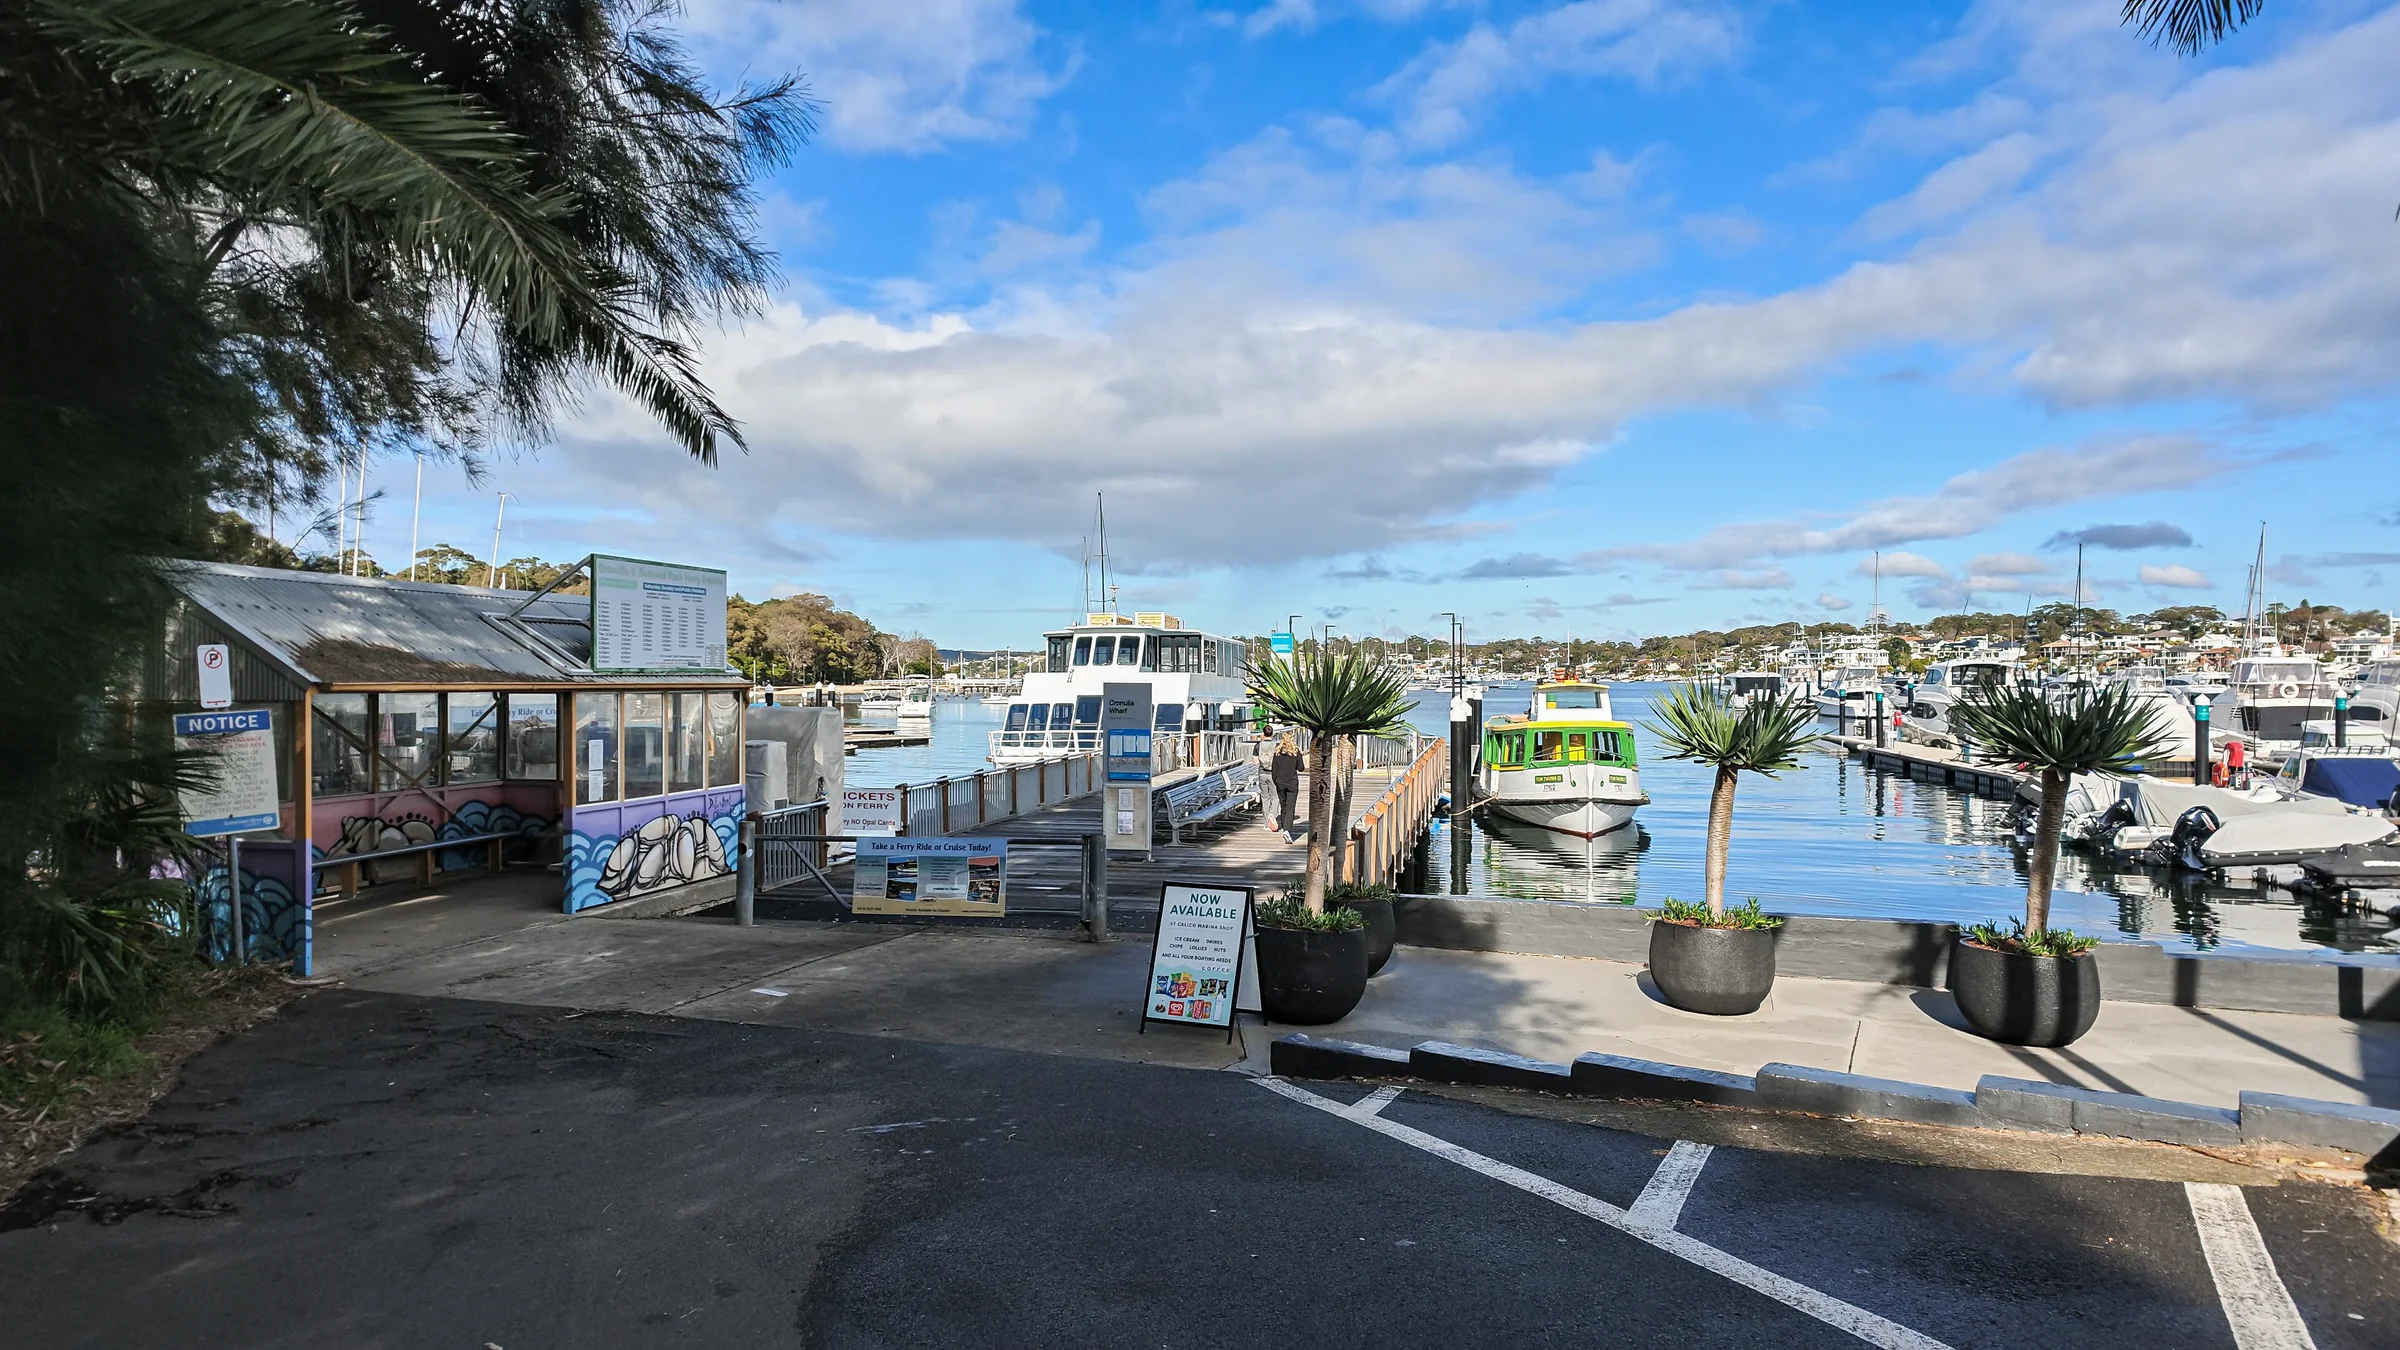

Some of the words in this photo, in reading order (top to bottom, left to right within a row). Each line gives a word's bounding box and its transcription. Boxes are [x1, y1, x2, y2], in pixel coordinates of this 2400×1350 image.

[189, 715, 258, 731] NOTICE
[844, 792, 895, 801] ICKETS
[871, 842, 888, 850] Take
[896, 843, 915, 851] Ferry
[917, 843, 932, 851] Ride
[943, 843, 966, 851] Cruise
[968, 843, 992, 852] Today!
[1190, 893, 1221, 905] NOW
[1170, 905, 1237, 919] AVAILABLE
[1201, 965, 1231, 973] COFFEE
